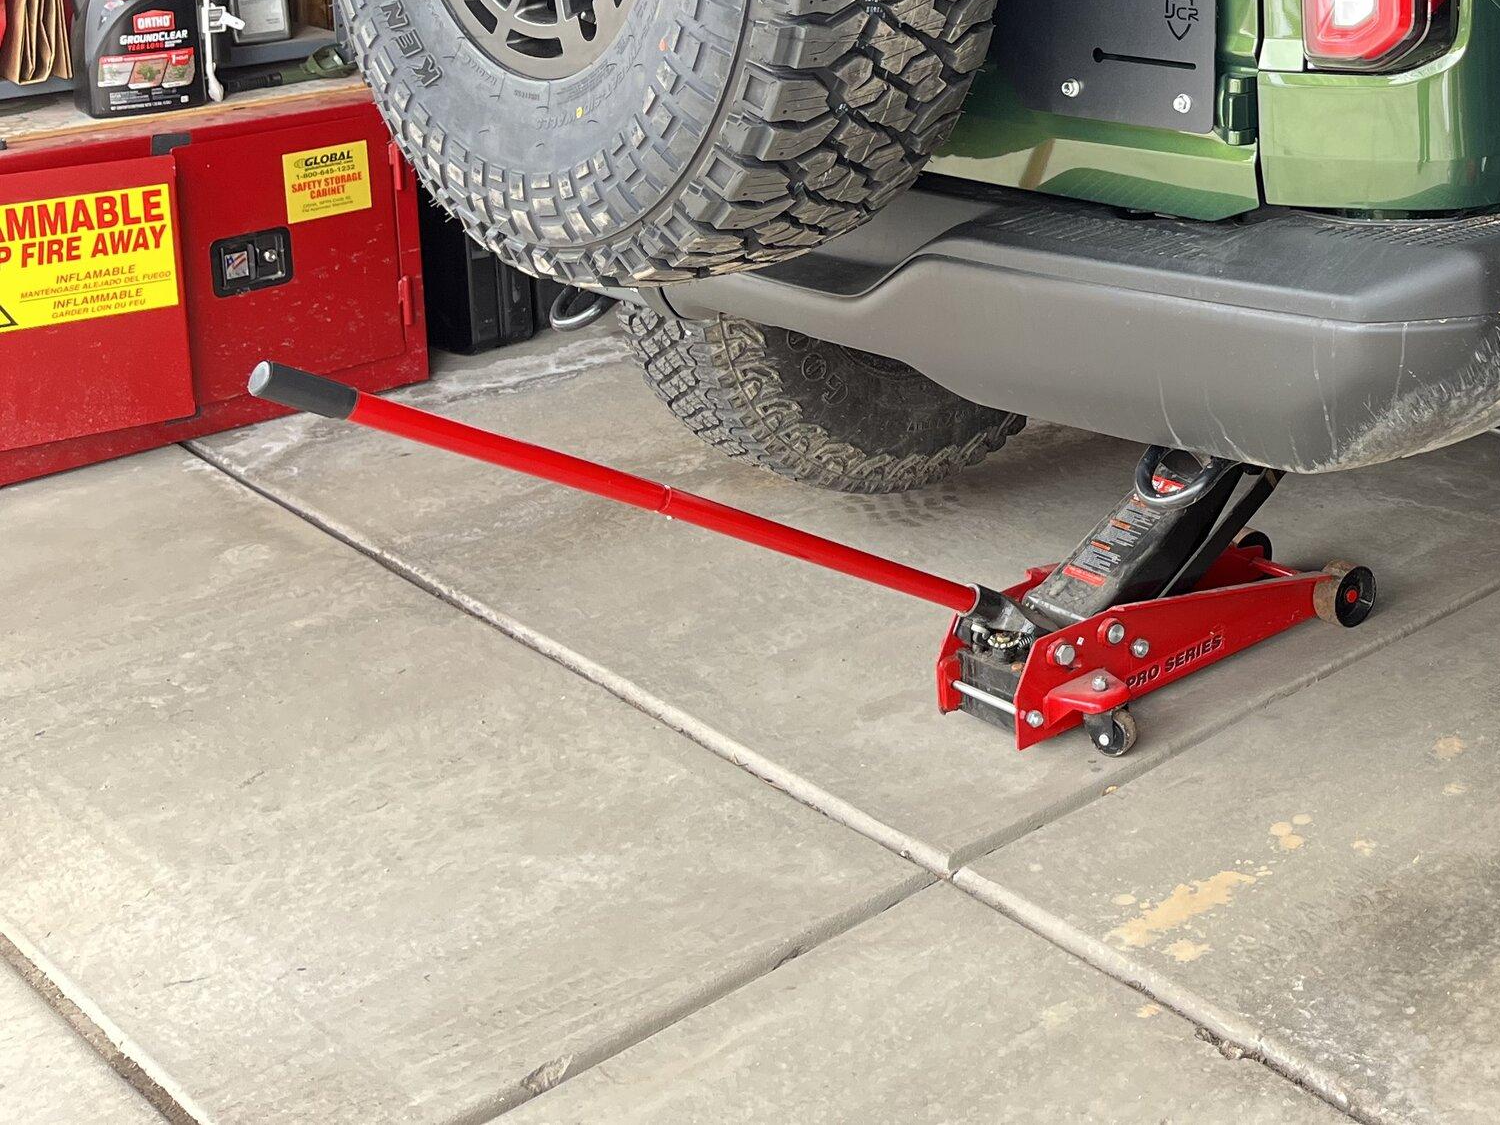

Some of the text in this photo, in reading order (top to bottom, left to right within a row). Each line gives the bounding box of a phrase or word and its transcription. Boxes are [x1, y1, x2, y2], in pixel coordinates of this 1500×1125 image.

[137, 15, 171, 30] ORTHO
[1164, 3, 1199, 22] JCR
[120, 29, 188, 45] GROUNDCLEAR
[304, 150, 353, 167] GLOBAL
[291, 171, 362, 193] SAFETY STORAGE
[310, 184, 346, 200] CABINET
[0, 189, 164, 243] MMABLE
[21, 236, 81, 268] FIRE
[91, 224, 166, 258] AWAY
[56, 264, 136, 284] INFLAMABLE
[82, 278, 121, 290] ALEJADO
[124, 275, 139, 284] DEL
[143, 270, 172, 281] FUEGO
[53, 287, 144, 310] INFLAMMABLE
[51, 299, 146, 319] GARDER LOIN DU FEU
[1126, 635, 1225, 689] PRO SERIES
